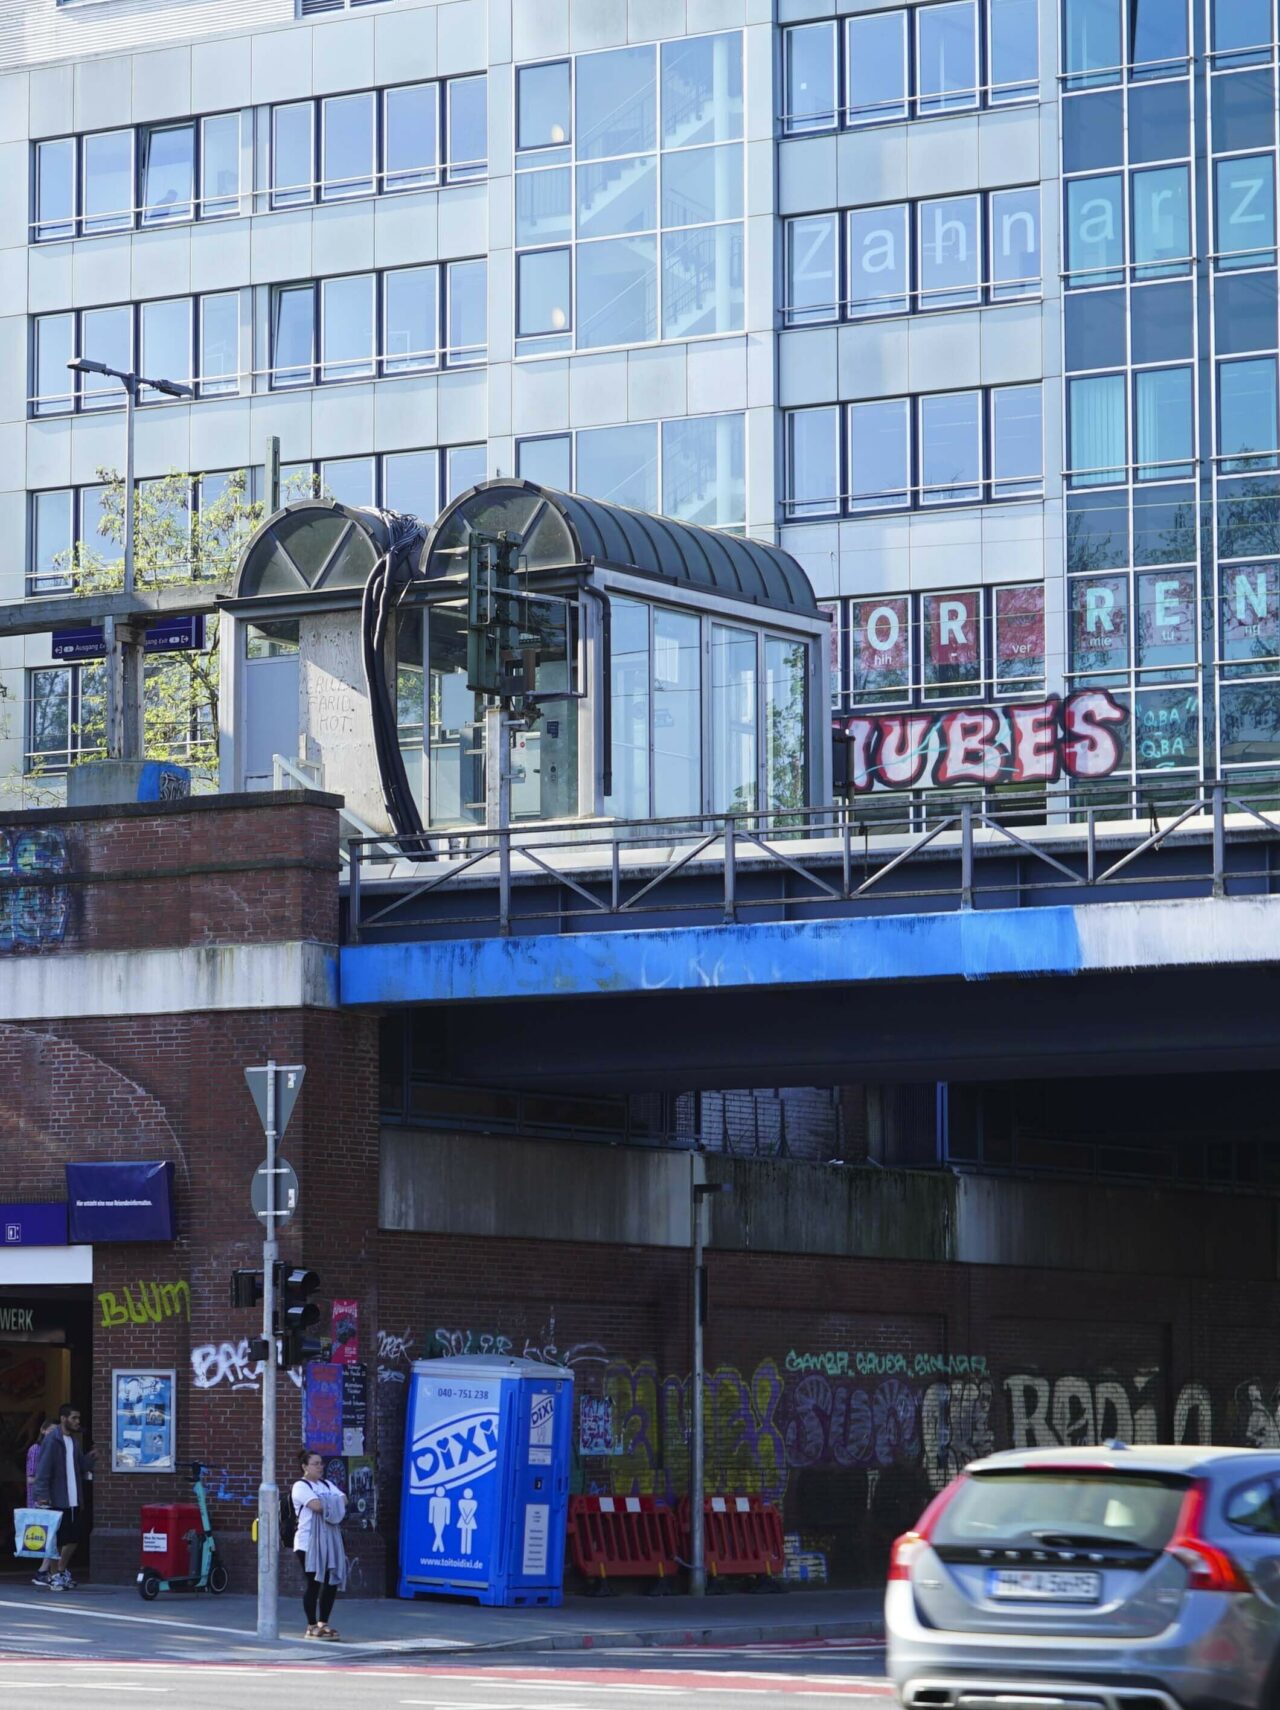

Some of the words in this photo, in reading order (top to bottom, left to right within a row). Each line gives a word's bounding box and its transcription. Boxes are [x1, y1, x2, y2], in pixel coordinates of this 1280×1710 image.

[438, 1388, 452, 1398] 040
[459, 1389, 472, 1399] 751
[474, 1390, 489, 1400] 238
[420, 1557, 484, 1569] www.toitoidixi.de
